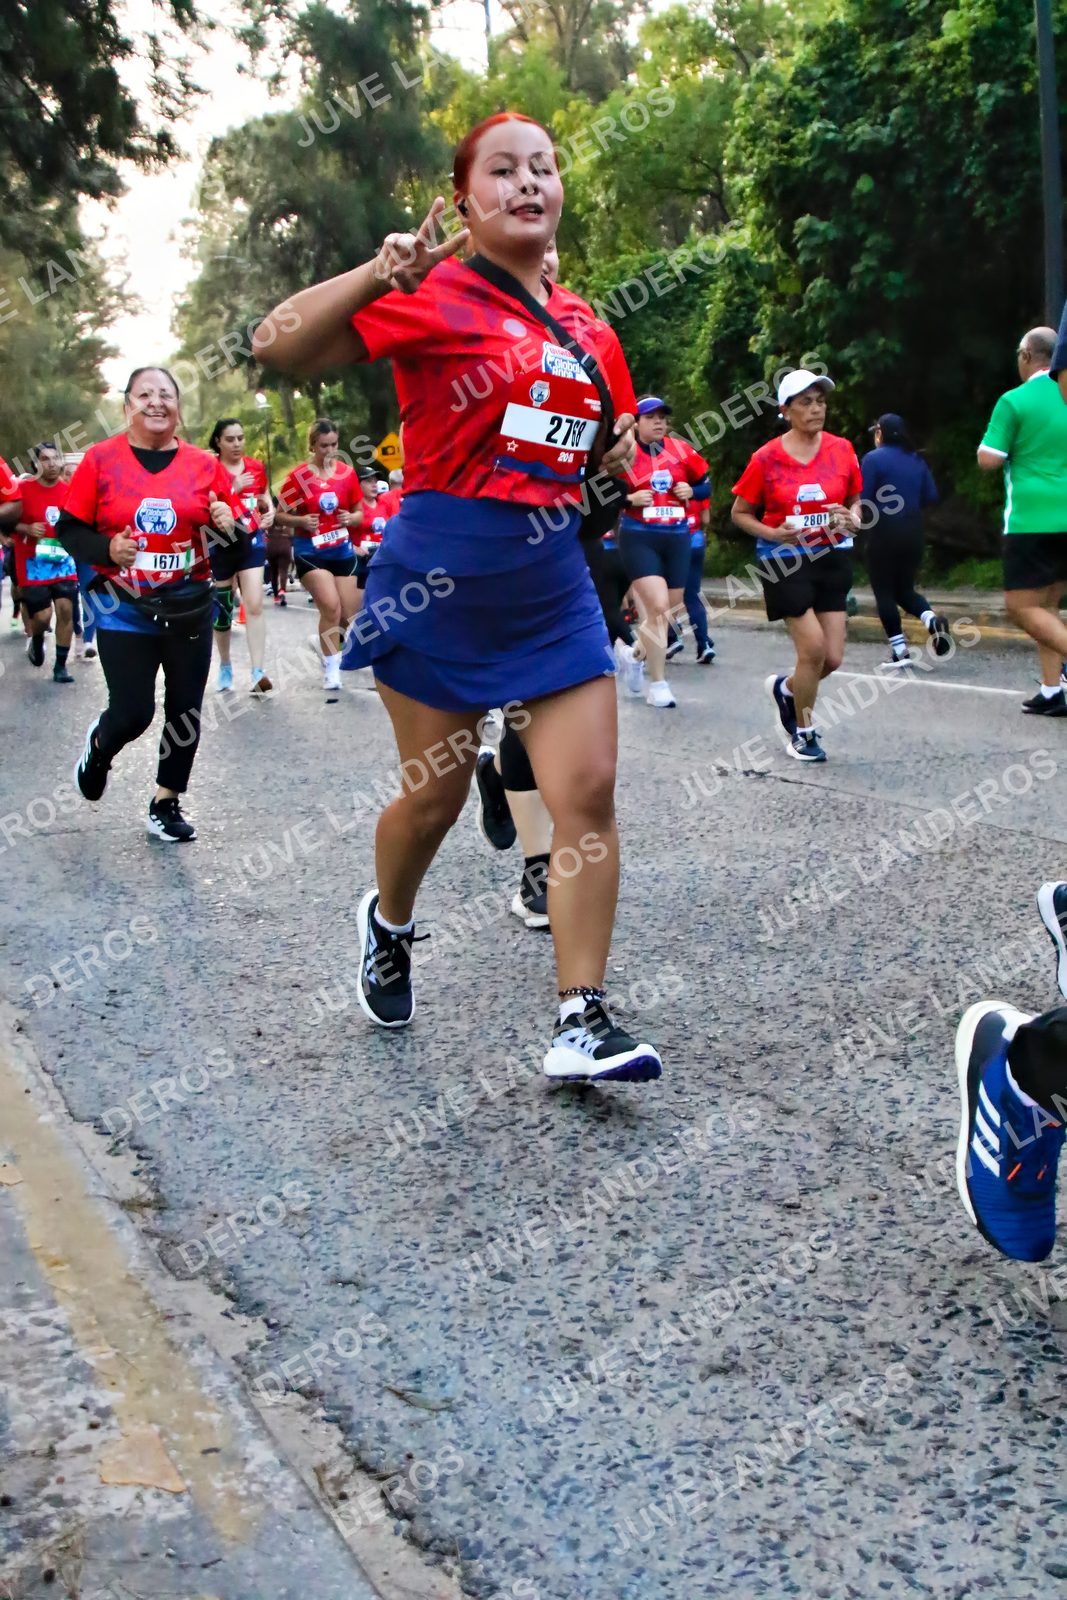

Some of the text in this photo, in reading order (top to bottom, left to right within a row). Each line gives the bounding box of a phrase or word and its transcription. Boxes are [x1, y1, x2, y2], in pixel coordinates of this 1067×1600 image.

[545, 415, 587, 448] 2768
[803, 513, 827, 526] 2801
[153, 554, 180, 569] 1671
